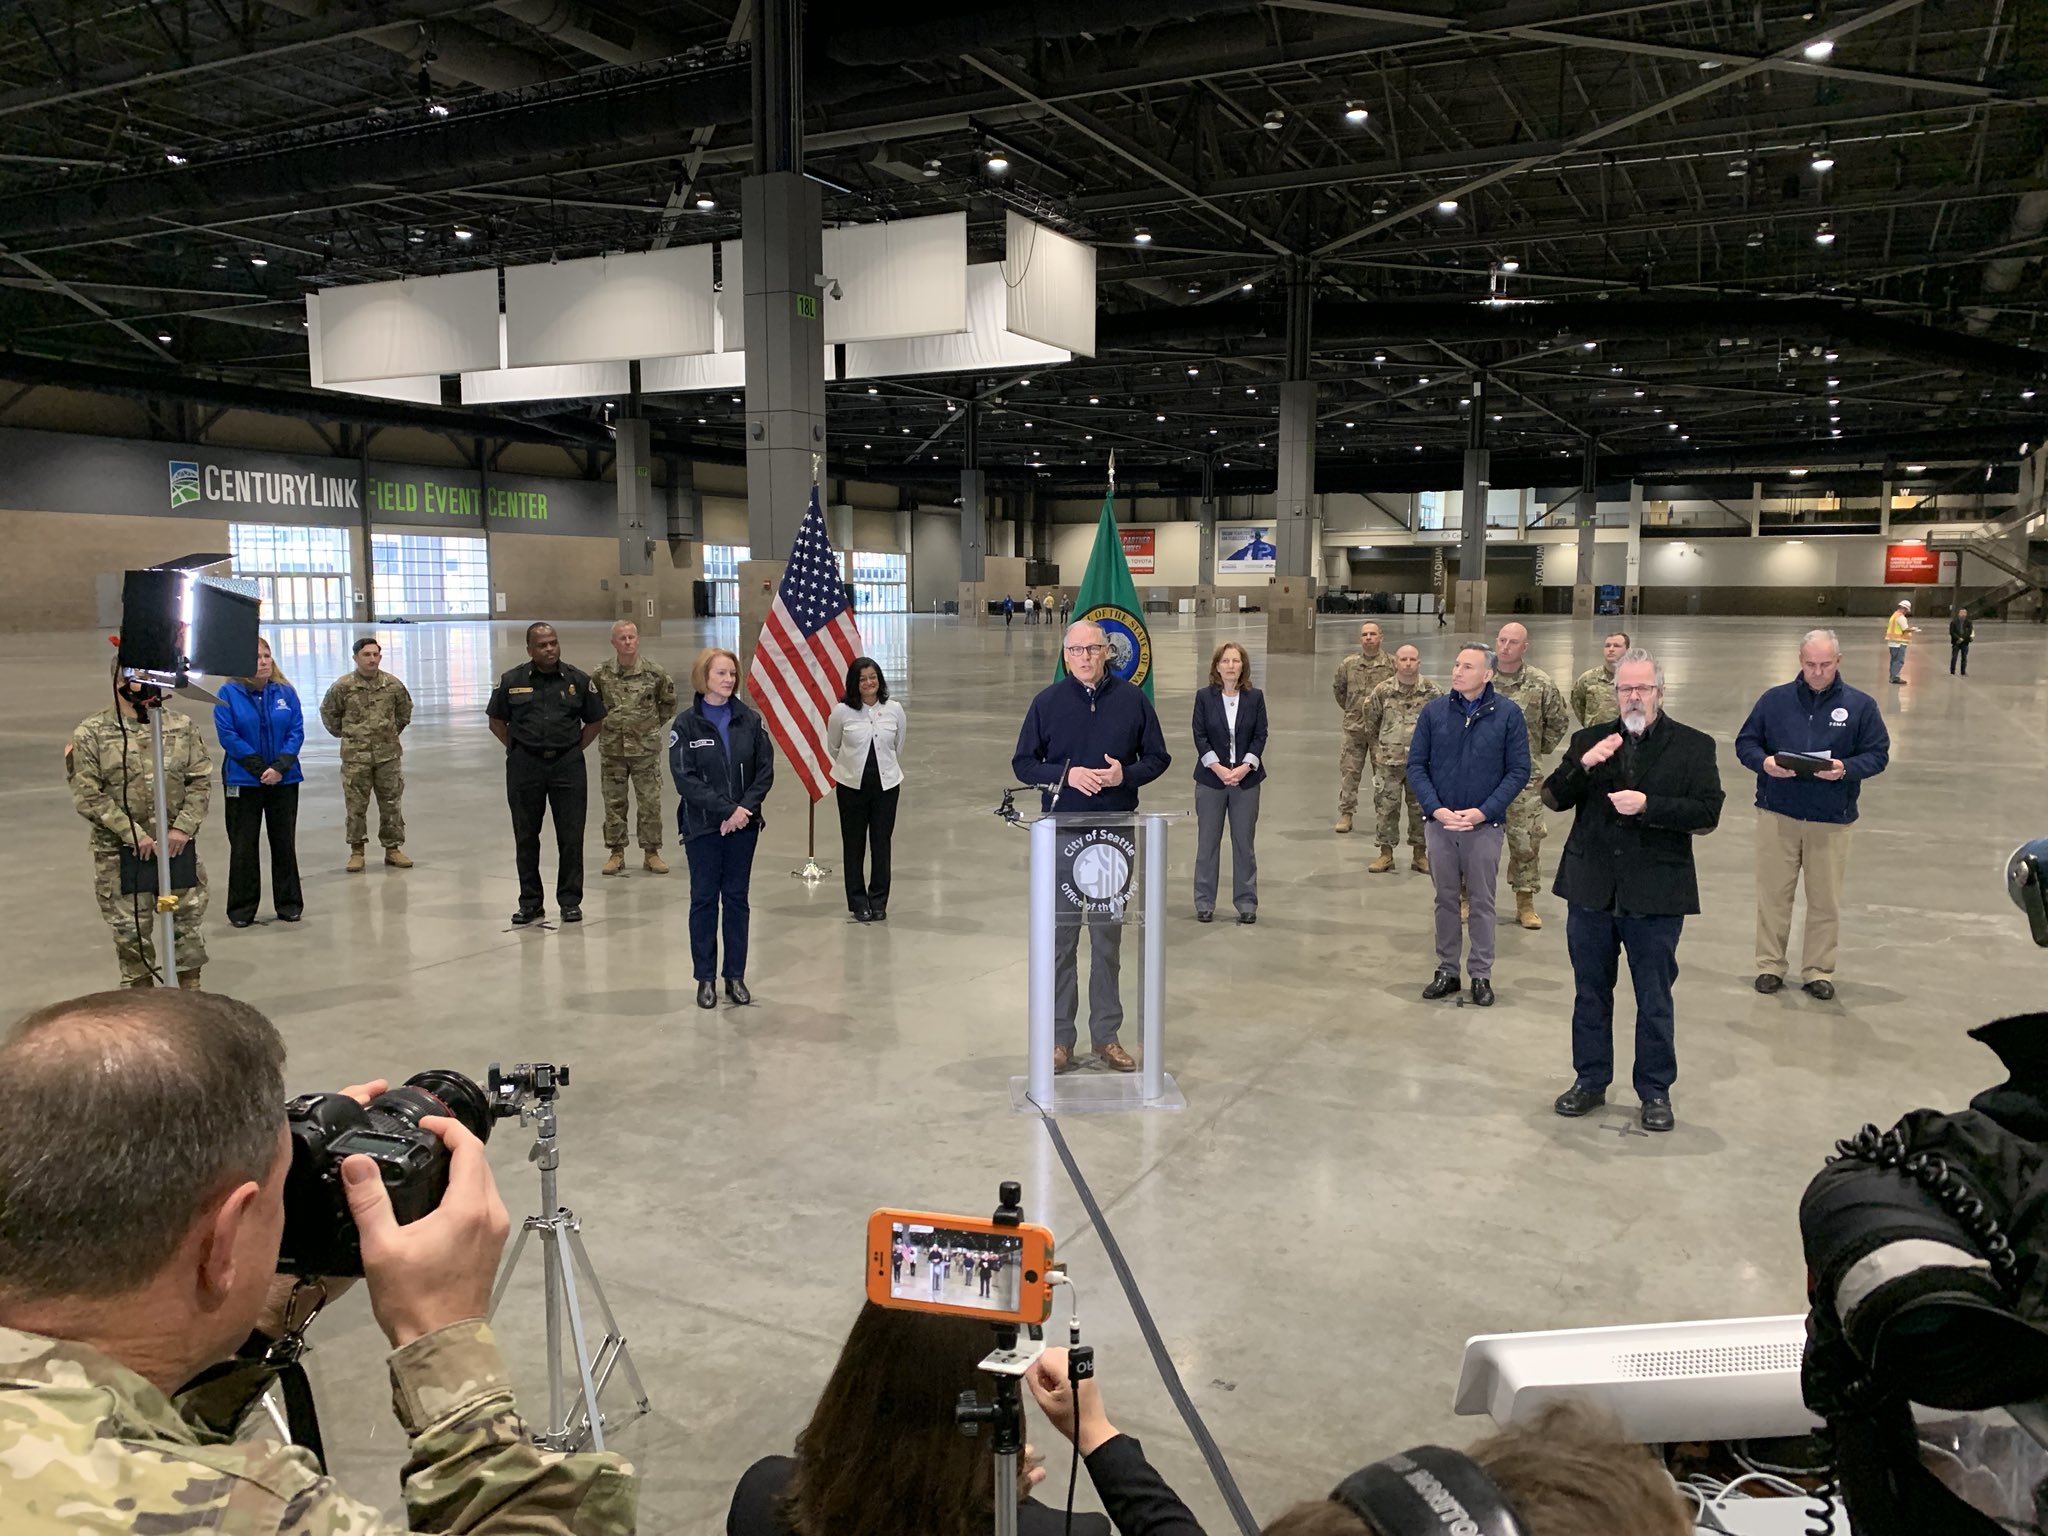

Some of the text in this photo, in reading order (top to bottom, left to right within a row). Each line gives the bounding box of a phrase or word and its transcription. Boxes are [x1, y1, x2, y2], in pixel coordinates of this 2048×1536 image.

[800, 297, 814, 317] 18L
[424, 482, 481, 515] EVENT
[487, 487, 548, 520] CENTER
[1899, 488, 1910, 496] W
[1433, 547, 1443, 586] STADIUM
[1535, 545, 1544, 586] STADIUM
[1109, 609, 1127, 622] THE
[1128, 621, 1147, 647] STATE
[1064, 829, 1136, 857] City of Seattle
[1061, 882, 1084, 908] Office
[1085, 902, 1097, 912] of
[1404, 1468, 1484, 1536] MONITO
